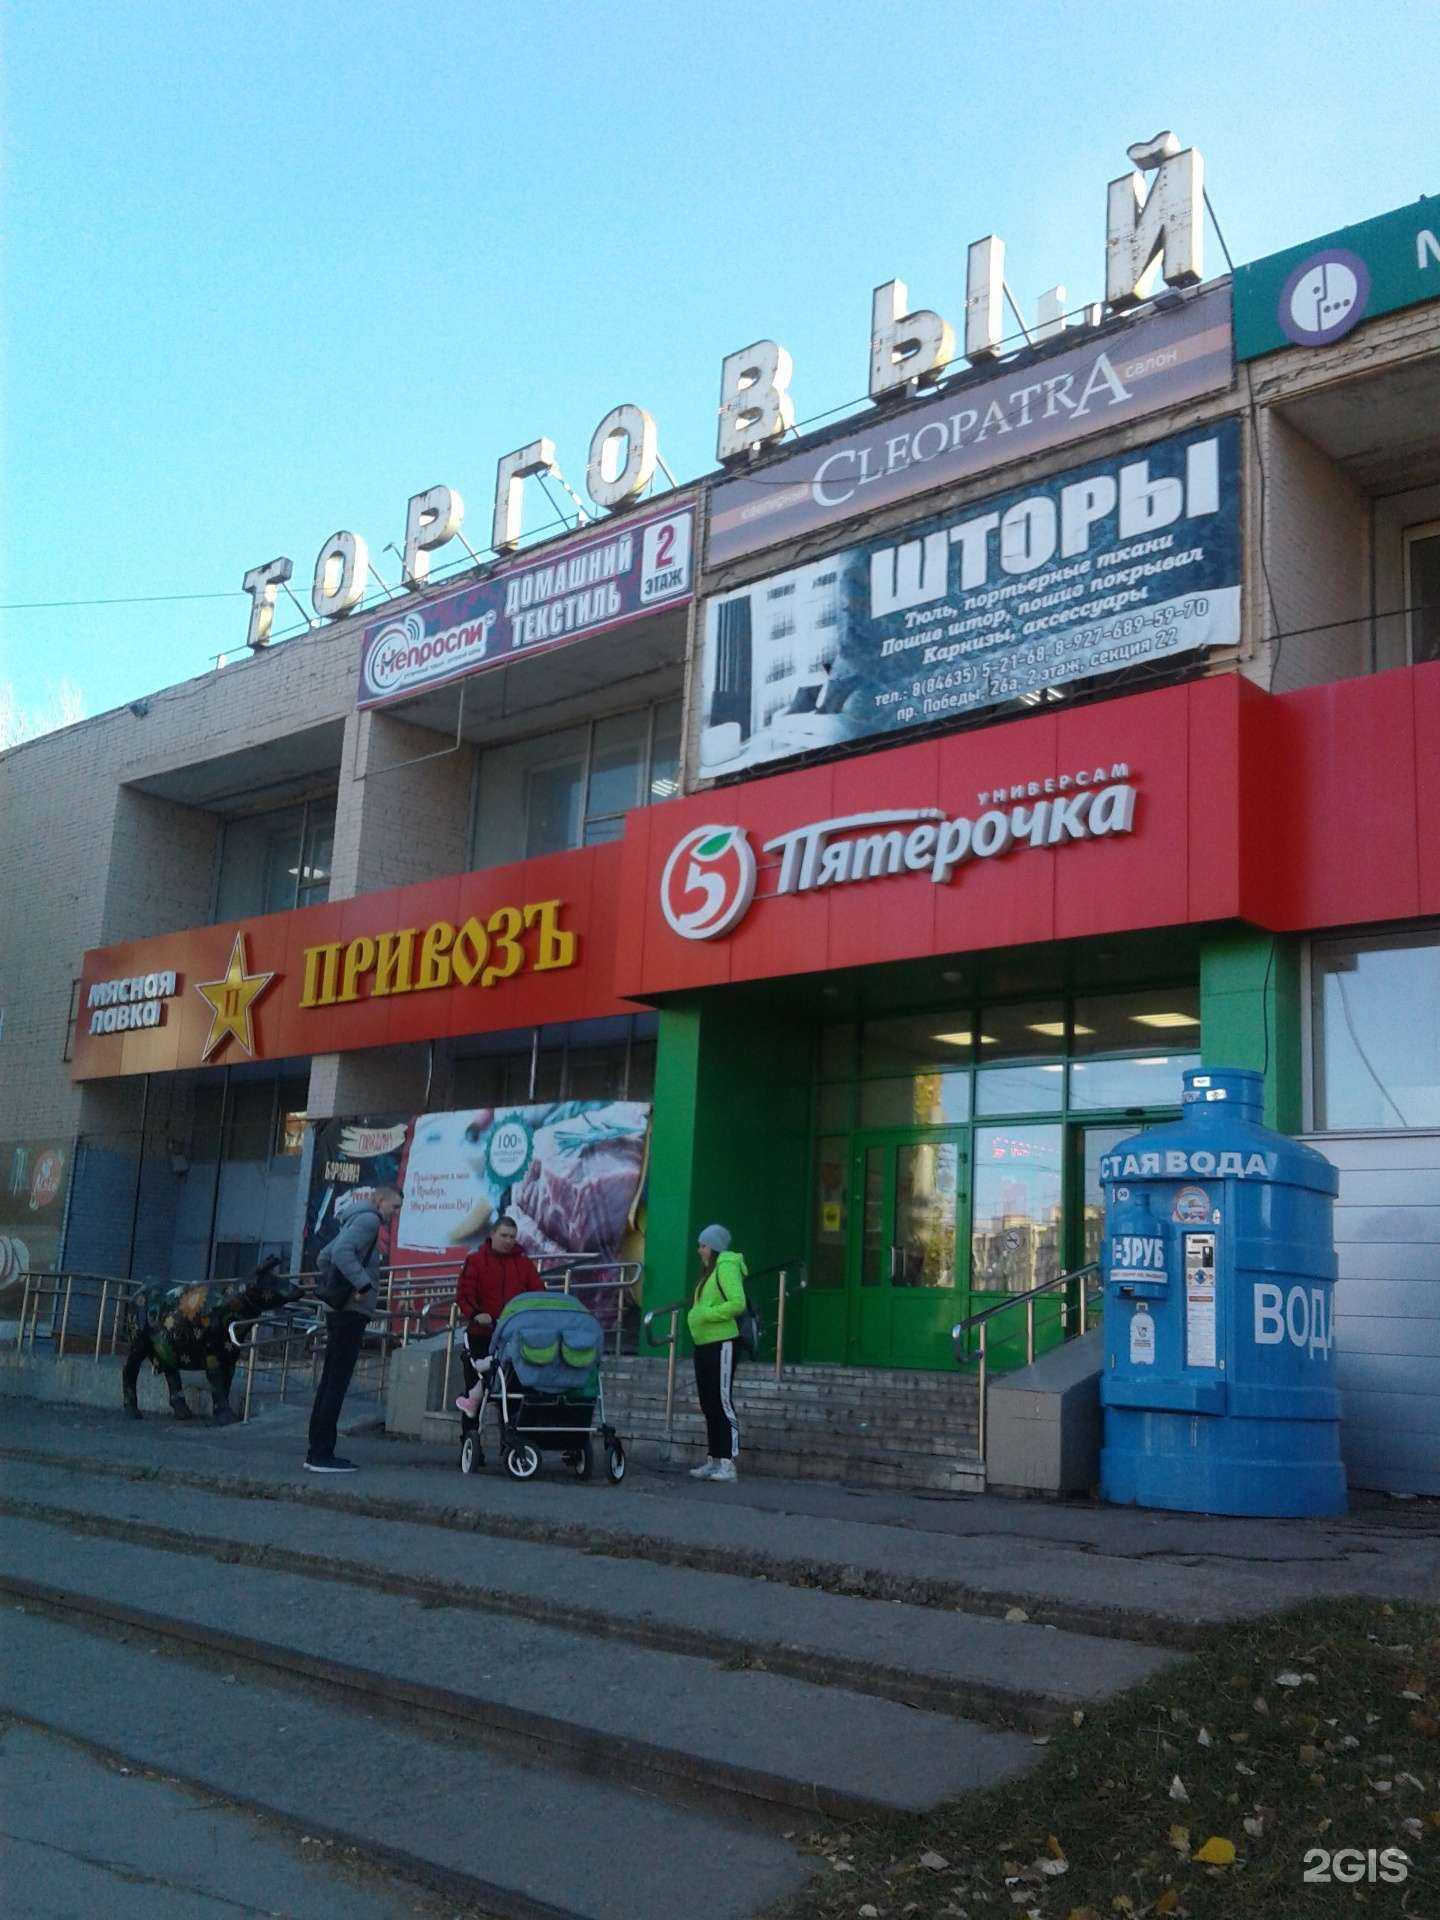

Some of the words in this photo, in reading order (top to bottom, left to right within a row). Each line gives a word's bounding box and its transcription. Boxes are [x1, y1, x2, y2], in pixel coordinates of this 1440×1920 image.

[243, 130, 1204, 650] ТОРГОВЫЙ
[1125, 347, 1178, 379] салон
[811, 353, 1134, 507] CLEOPATRA
[654, 524, 675, 569] 2
[871, 437, 1219, 619] ШТОРЫ
[505, 532, 634, 617] ДОМАШНИЙ
[512, 581, 621, 648] ТЕКСТИЛЬ
[643, 568, 685, 596] ЭТАЖ
[880, 629, 943, 658] Пошив
[948, 609, 1011, 637] штор,
[1018, 583, 1084, 616] пошив
[1090, 547, 1204, 592] покрывал
[905, 604, 958, 629] Тюль,
[964, 560, 1091, 610] портьерные
[1097, 534, 1174, 569] ткани
[922, 629, 1016, 664] Карнизы,
[1022, 586, 1149, 636] аксессуары
[1055, 599, 1208, 656] 8-927-689-59-70
[897, 706, 917, 723] пр.
[1041, 659, 1085, 681] этаж,
[1090, 641, 1150, 667] секция
[1155, 628, 1178, 650] 22
[978, 762, 1131, 807] УНИВЕРСАМ
[300, 900, 577, 1009] ПРИВОЗЪ
[1165, 1151, 1268, 1178] ВОДА
